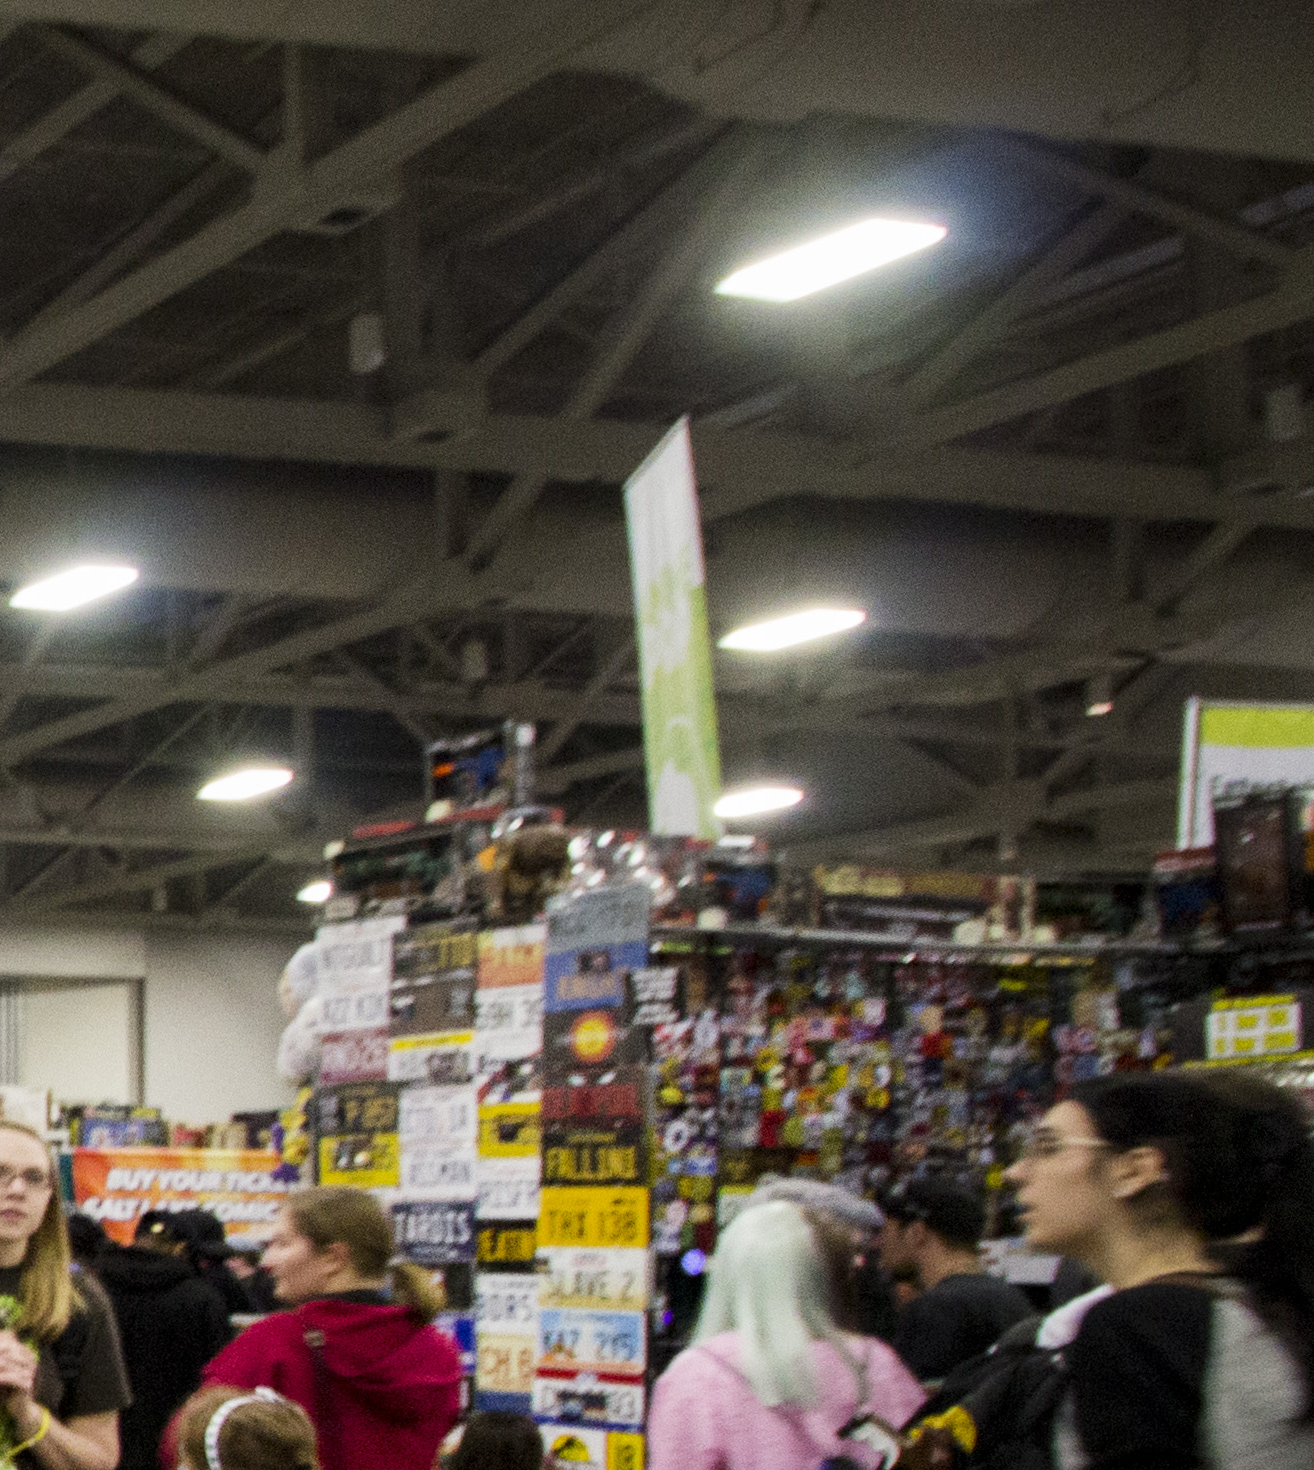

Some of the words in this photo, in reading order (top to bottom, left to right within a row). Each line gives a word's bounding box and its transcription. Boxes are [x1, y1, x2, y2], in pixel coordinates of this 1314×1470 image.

[105, 1167, 158, 1192] BUY
[158, 1169, 223, 1192] YOUR
[203, 1200, 279, 1223] OMIC
[394, 1212, 471, 1244] TARDIS
[596, 1210, 638, 1242] 138
